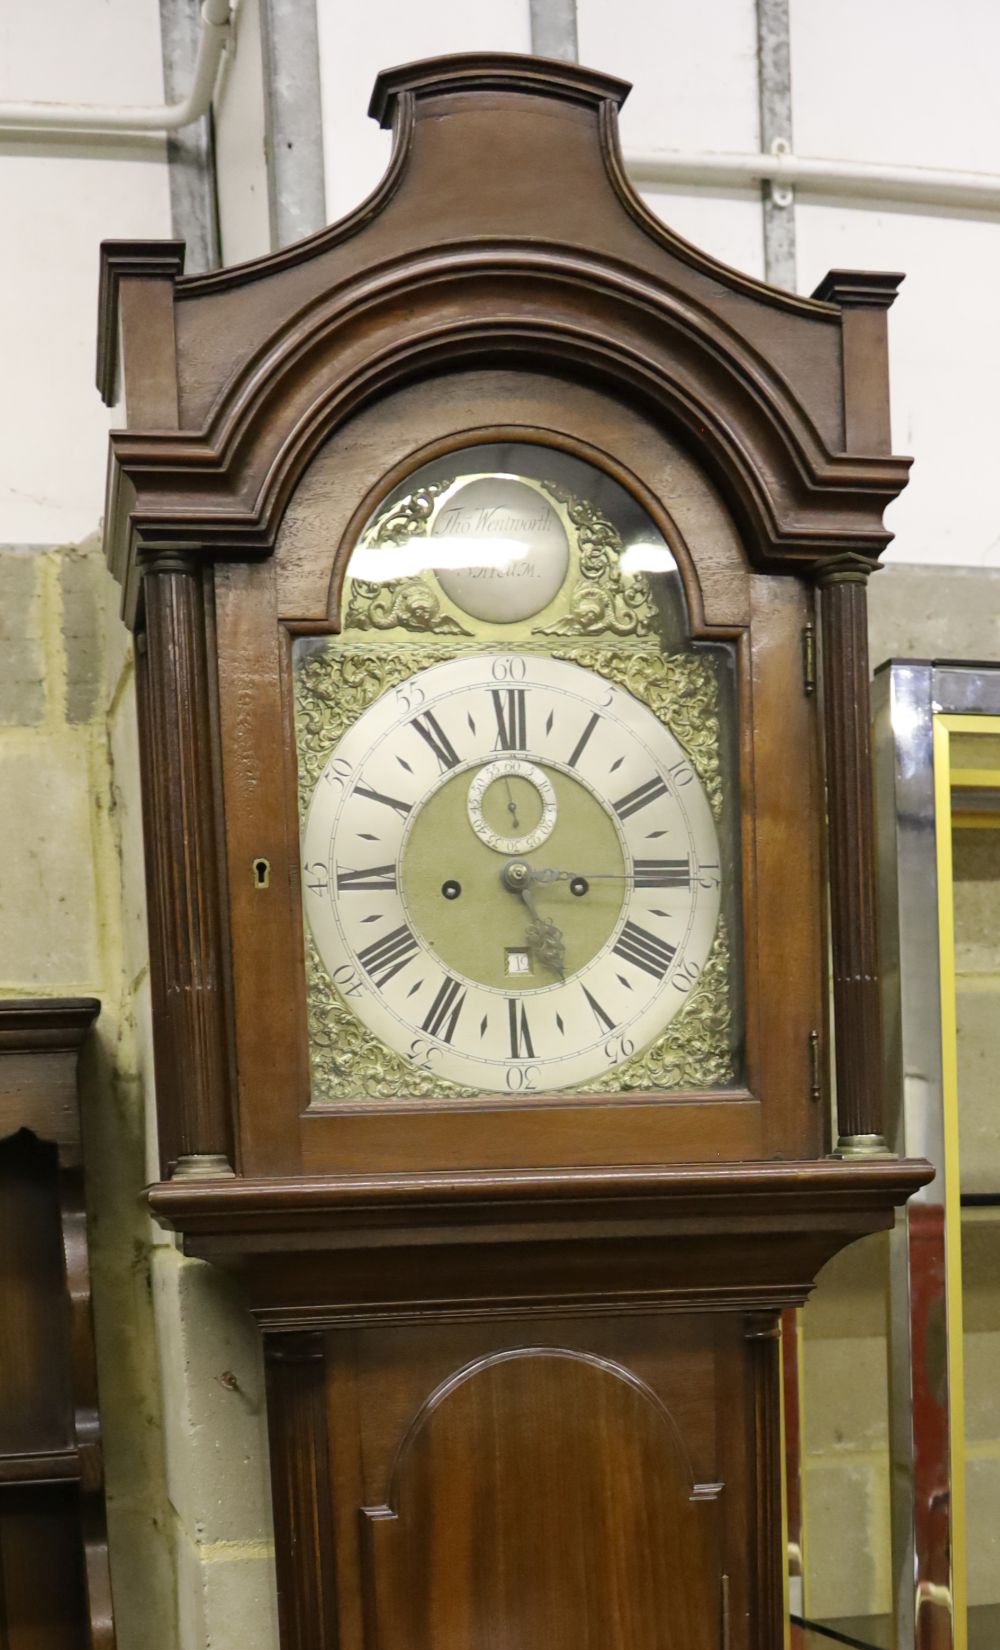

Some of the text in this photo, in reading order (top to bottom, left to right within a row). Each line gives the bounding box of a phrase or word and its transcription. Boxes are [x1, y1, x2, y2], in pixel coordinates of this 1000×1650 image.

[475, 504, 555, 532] Wentworth
[490, 655, 527, 681] 60
[396, 681, 425, 715] 55
[602, 686, 618, 708] 5
[488, 688, 531, 752] XII
[403, 706, 467, 777] XI
[564, 710, 605, 769] I
[325, 758, 353, 793] 50
[504, 761, 521, 772] 60
[667, 759, 694, 788] 10
[350, 772, 416, 826] X
[608, 769, 672, 827] II
[304, 862, 330, 898] 45
[336, 859, 399, 900] IX
[632, 852, 692, 893] III
[698, 865, 721, 889] 15
[353, 919, 423, 995] VIII
[609, 915, 680, 988] IIII
[333, 964, 364, 998] 40
[416, 972, 468, 1047] VII
[503, 997, 541, 1060] VI
[579, 981, 623, 1038] V
[404, 1039, 443, 1070] 35
[506, 1066, 541, 1090] 30
